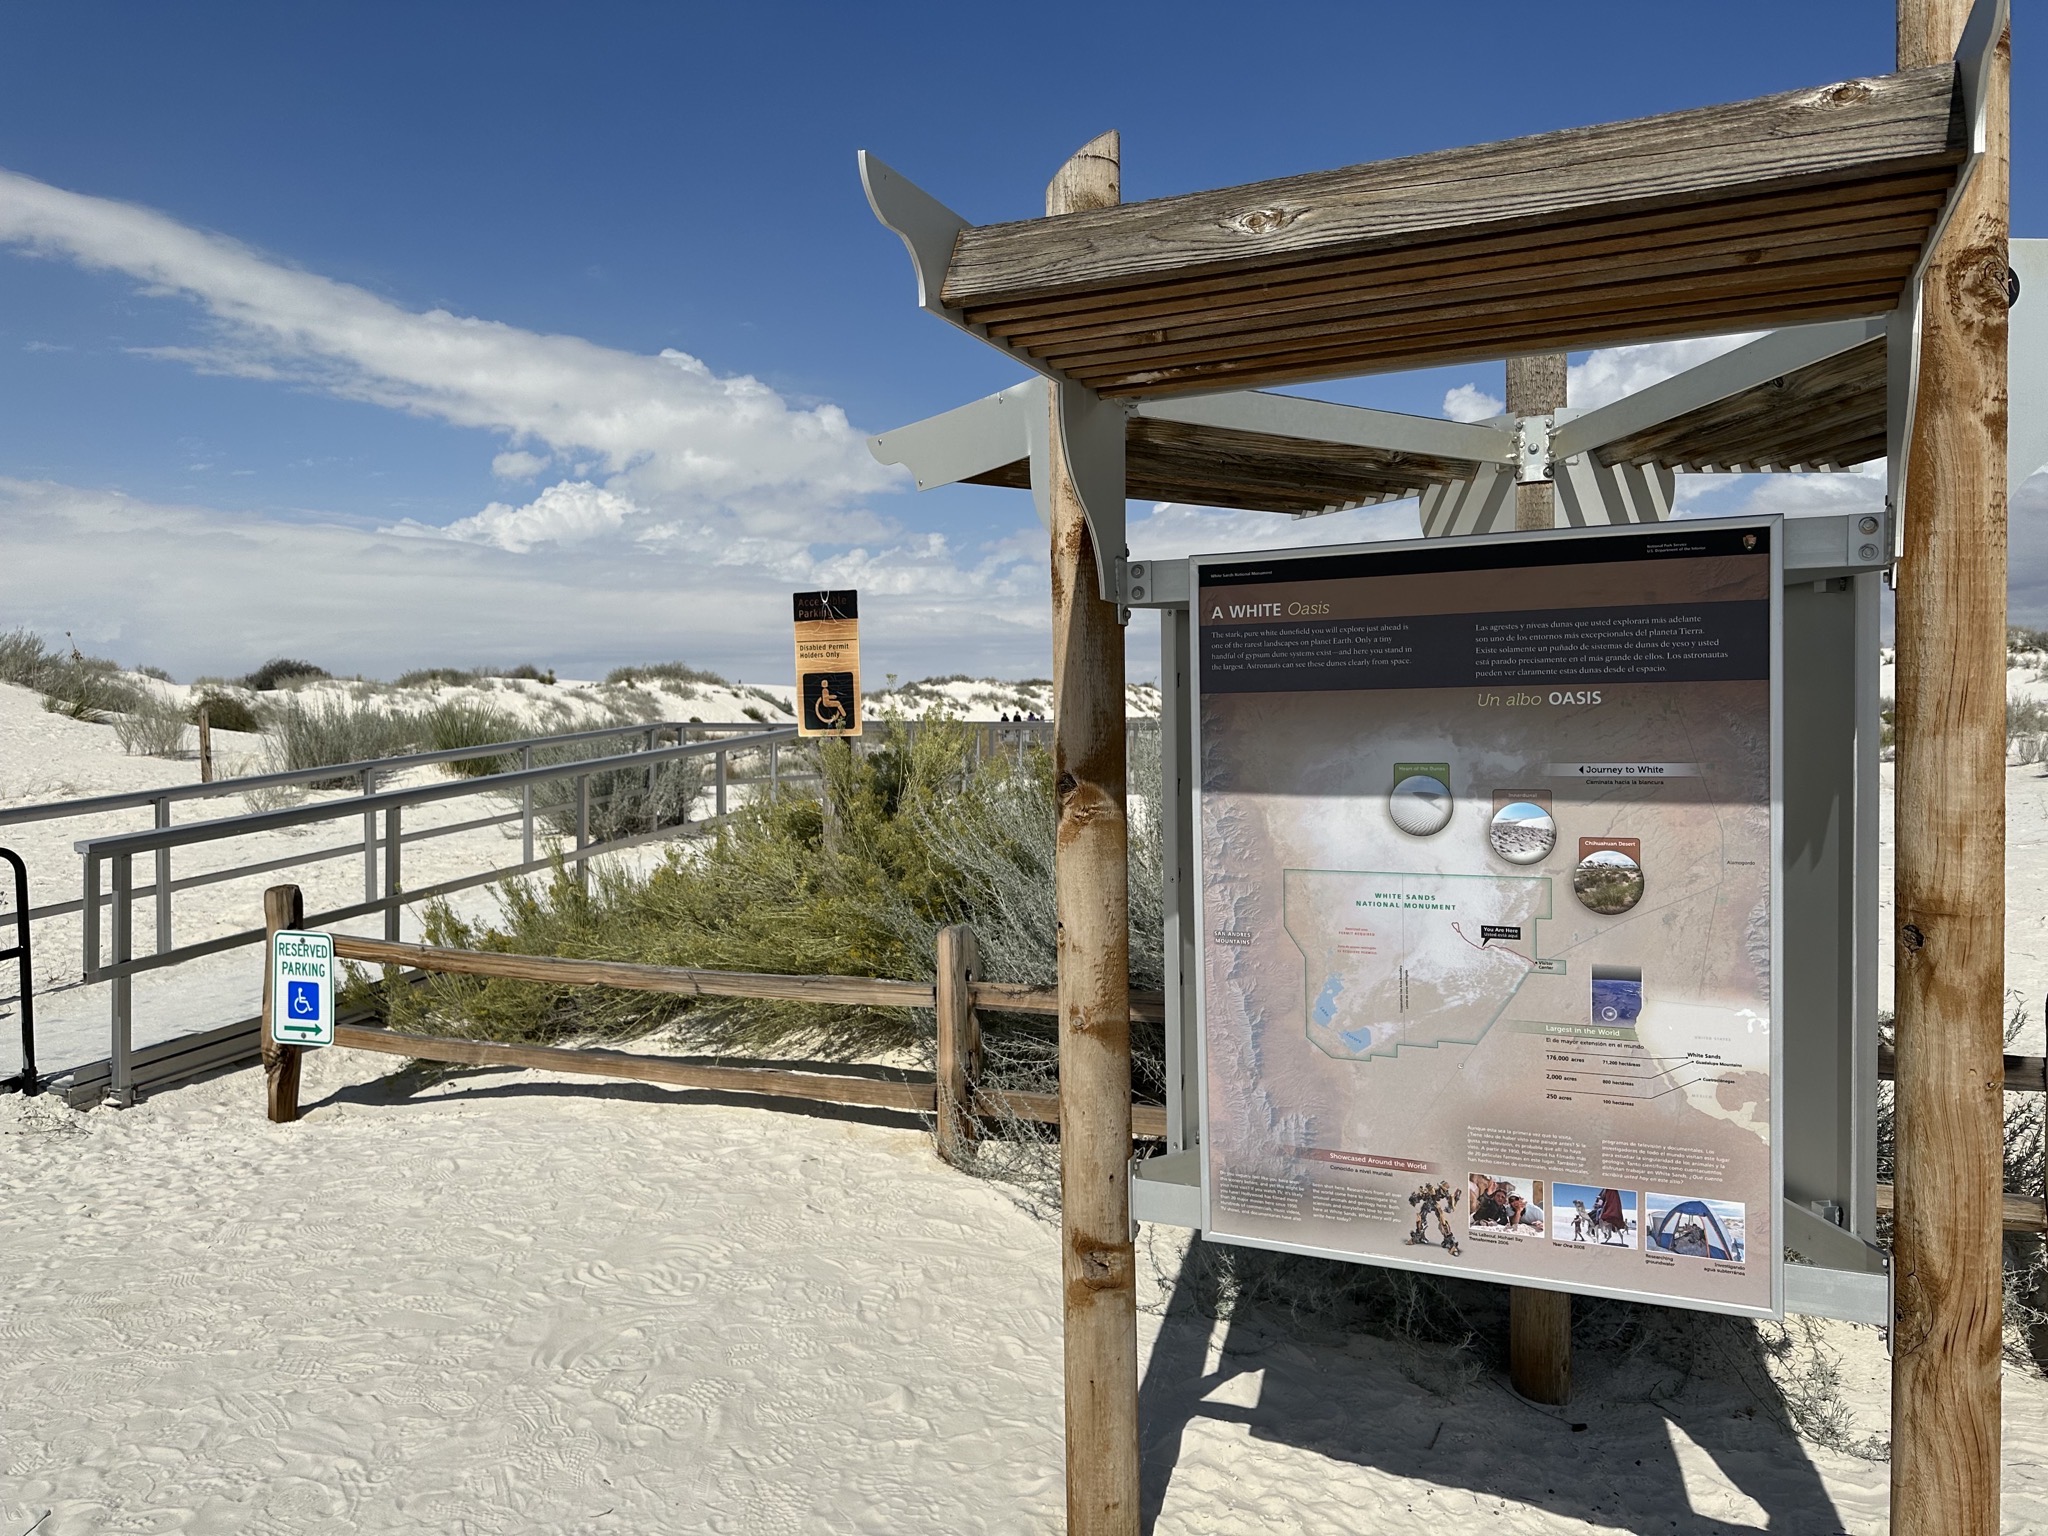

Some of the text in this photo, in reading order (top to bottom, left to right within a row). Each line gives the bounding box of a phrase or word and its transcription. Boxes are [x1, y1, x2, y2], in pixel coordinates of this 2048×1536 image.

[799, 595, 847, 606] Acceble
[799, 609, 832, 618] Parking
[1212, 601, 1330, 619] A WHITE Oasis
[1225, 630, 1242, 640] stark,
[1279, 627, 1310, 636] dunefield
[1339, 625, 1365, 635] explore
[1366, 624, 1379, 634] just
[1380, 623, 1401, 632] ahead
[1490, 623, 1518, 633] agrestes
[1526, 622, 1549, 630] níveas
[1550, 621, 1573, 629] dunas
[1613, 618, 1650, 628] explorará
[1668, 616, 1701, 624] adelante
[1529, 632, 1562, 641] entornos
[1581, 630, 1634, 641] excepcionales
[1649, 629, 1678, 639] planeta
[1264, 639, 1299, 649] landscapes
[1310, 638, 1331, 648] planet
[1355, 636, 1371, 646] Only
[1379, 636, 1392, 645] tiny
[1499, 645, 1536, 653] solamente
[1549, 644, 1578, 654] puñado
[1591, 642, 1622, 650] sistemas
[1635, 641, 1659, 649] dunas
[1212, 652, 1236, 660] handful
[1246, 652, 1270, 660] gypsum
[1290, 649, 1315, 659] systems
[1491, 657, 1517, 667] parado
[1518, 656, 1567, 666] precisamente
[1605, 654, 1631, 664] grande
[1683, 651, 1728, 660] astronautas
[1223, 662, 1245, 672] largest.
[1247, 661, 1281, 669] Astronauts
[1348, 658, 1370, 668] clearly
[1475, 669, 1502, 679] pueden
[1517, 668, 1558, 676] claramente
[1636, 665, 1666, 675] espacio.
[1478, 692, 1601, 707] Un albo OASIS
[1586, 766, 1623, 775] Journey
[279, 943, 327, 958] RESERVED
[282, 962, 325, 977] PARKING
[1546, 1026, 1572, 1035] Largest
[1330, 1153, 1366, 1163] Showcased
[1368, 1157, 1392, 1166] Around
[1407, 1162, 1427, 1170] World
